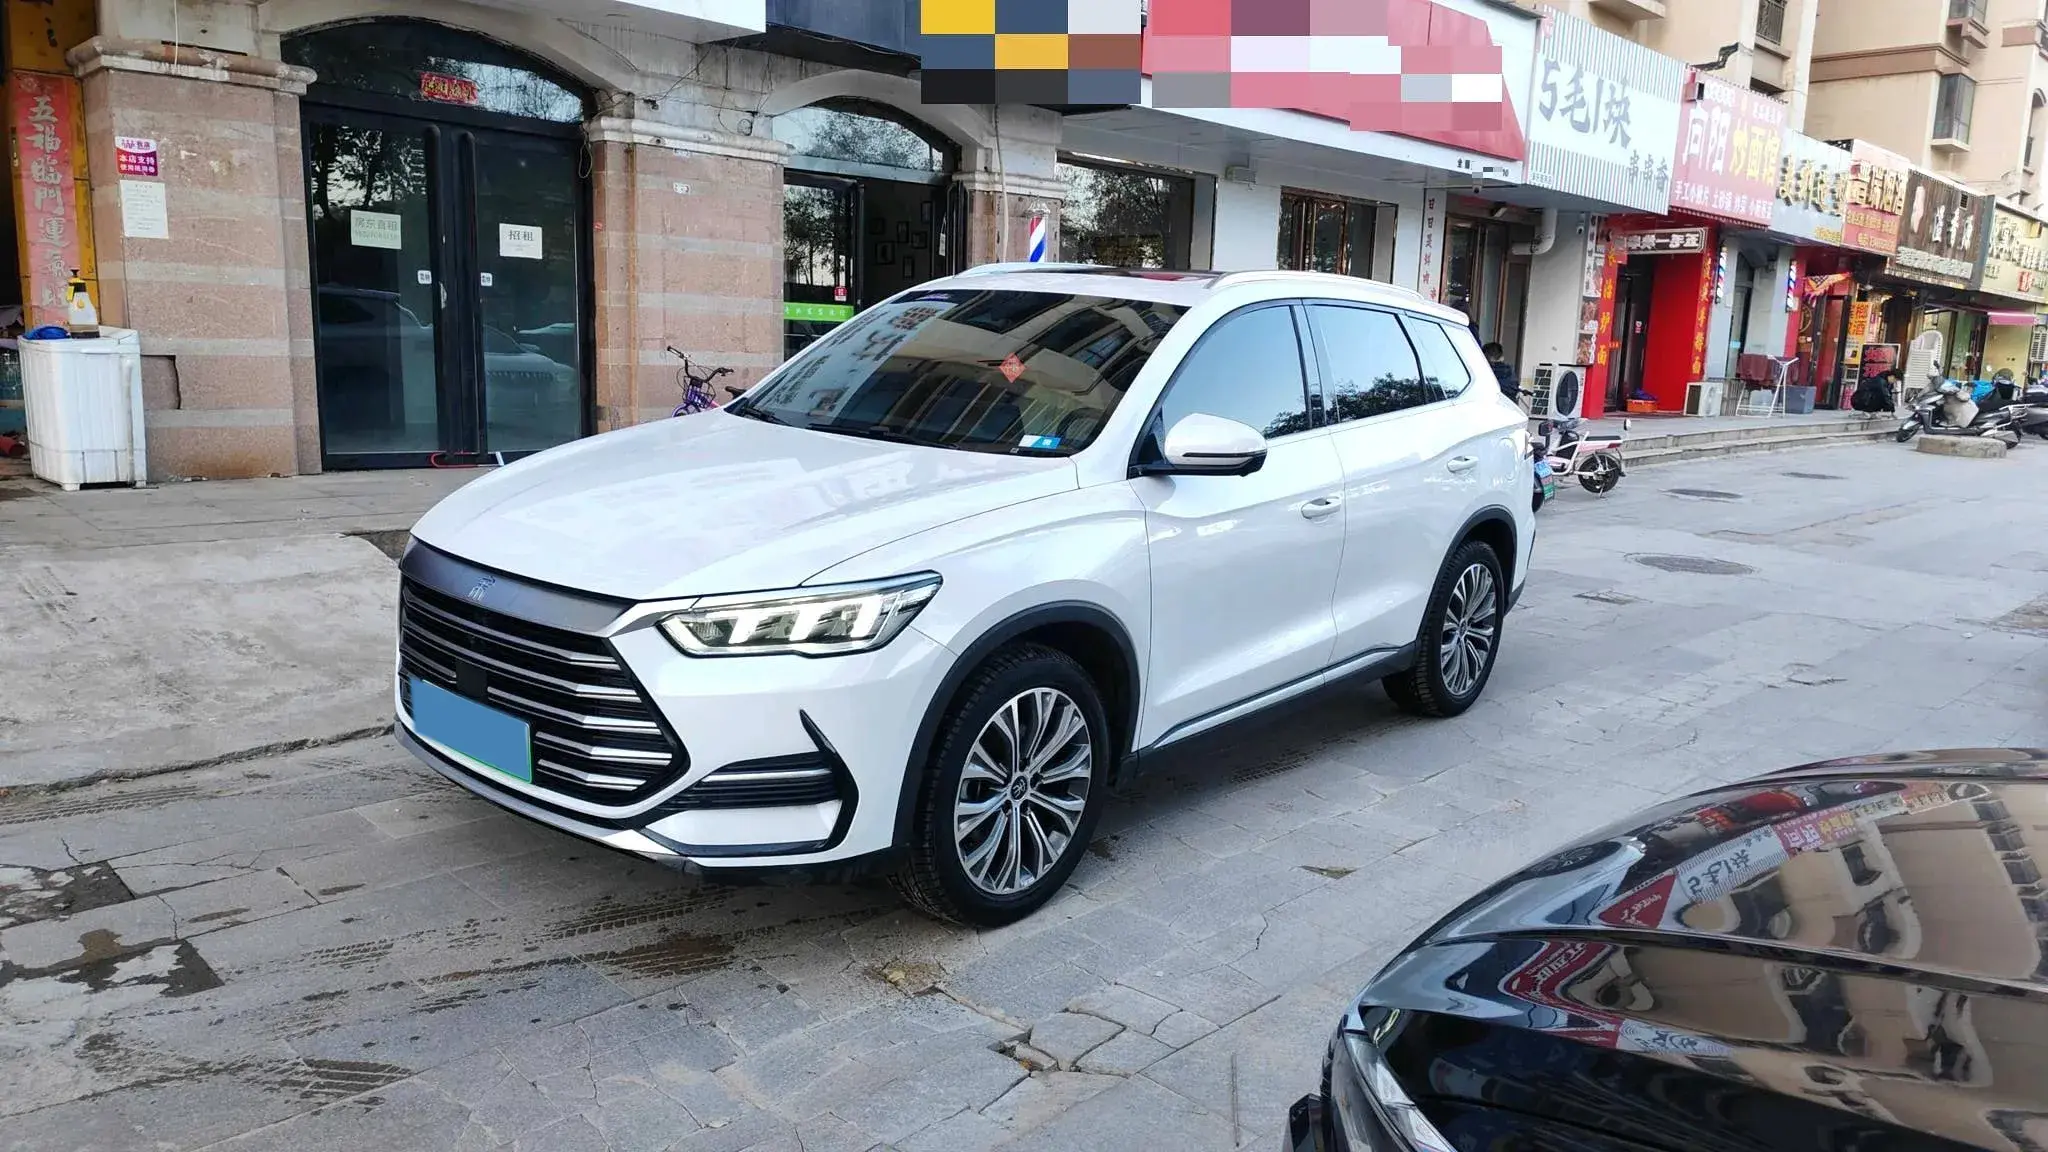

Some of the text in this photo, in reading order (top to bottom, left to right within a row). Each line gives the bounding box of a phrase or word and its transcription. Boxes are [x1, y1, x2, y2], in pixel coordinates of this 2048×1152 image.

[1539, 59, 1632, 149] 5毛1块
[119, 153, 155, 165] 本店支持
[508, 229, 535, 242] 招租
